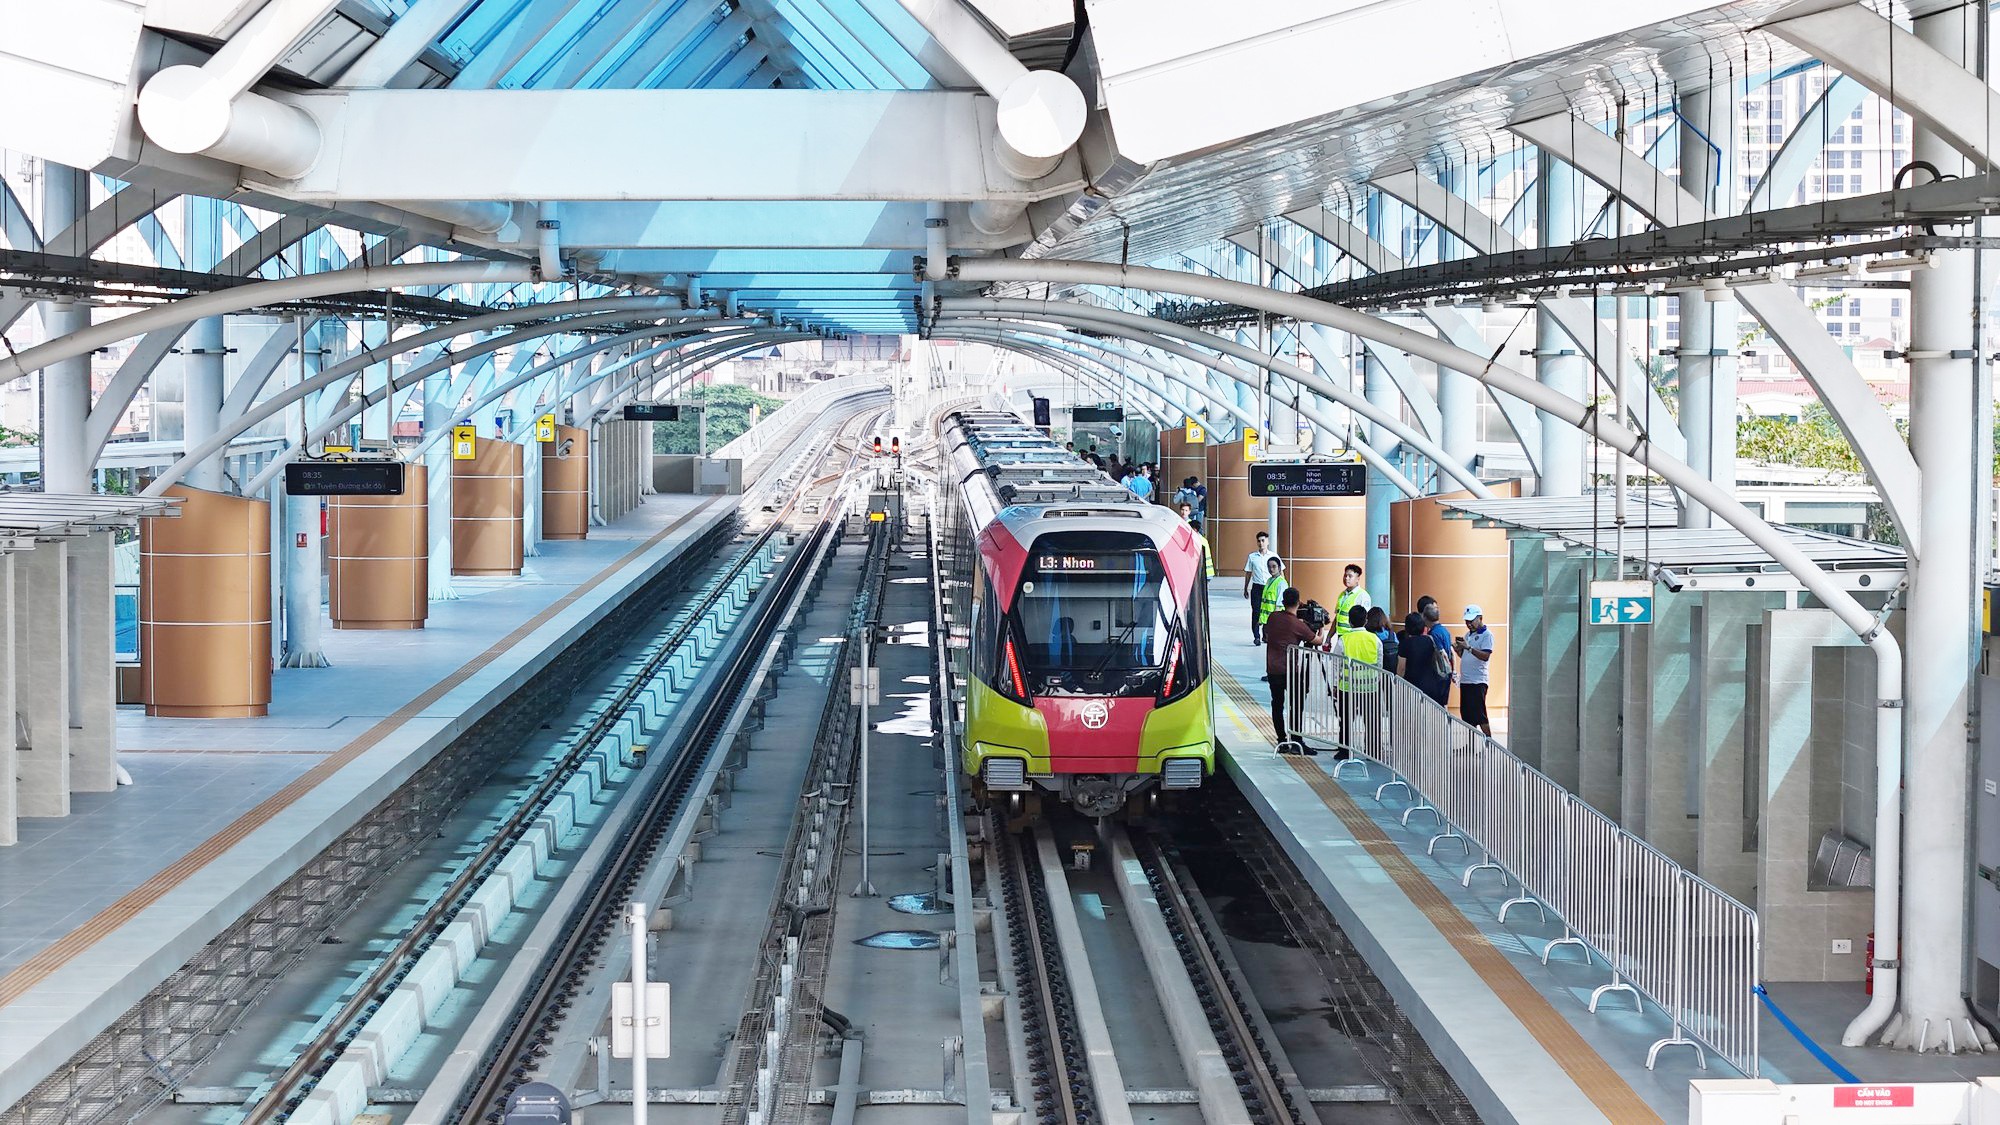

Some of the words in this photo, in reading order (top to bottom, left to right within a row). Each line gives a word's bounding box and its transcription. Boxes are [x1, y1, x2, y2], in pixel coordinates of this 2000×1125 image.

[302, 471, 322, 479] 08:35
[1281, 484, 1300, 492] Tuyến
[1039, 556, 1058, 568] L3:
[1062, 556, 1094, 568] Nhon
[1857, 1087, 1874, 1097] CẤM
[1875, 1087, 1891, 1097] VÀO
